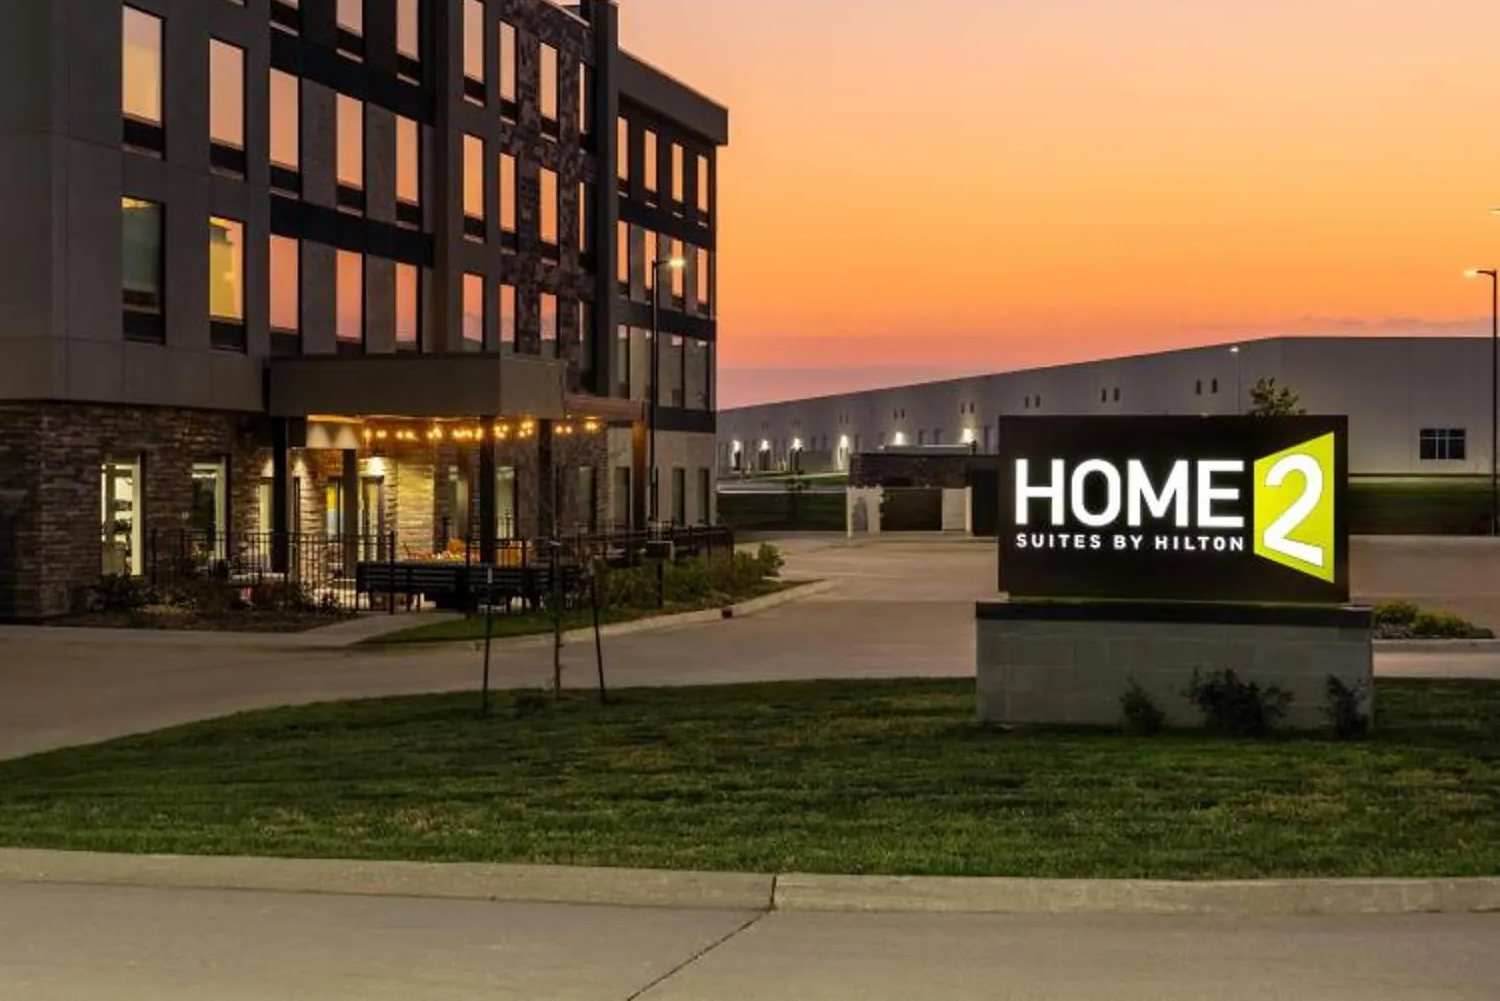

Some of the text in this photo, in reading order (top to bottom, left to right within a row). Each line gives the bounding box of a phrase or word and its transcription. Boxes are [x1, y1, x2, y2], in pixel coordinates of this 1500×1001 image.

[1015, 454, 1323, 567] HOME 2
[1016, 533, 1244, 551] SUITES BY HILTON
